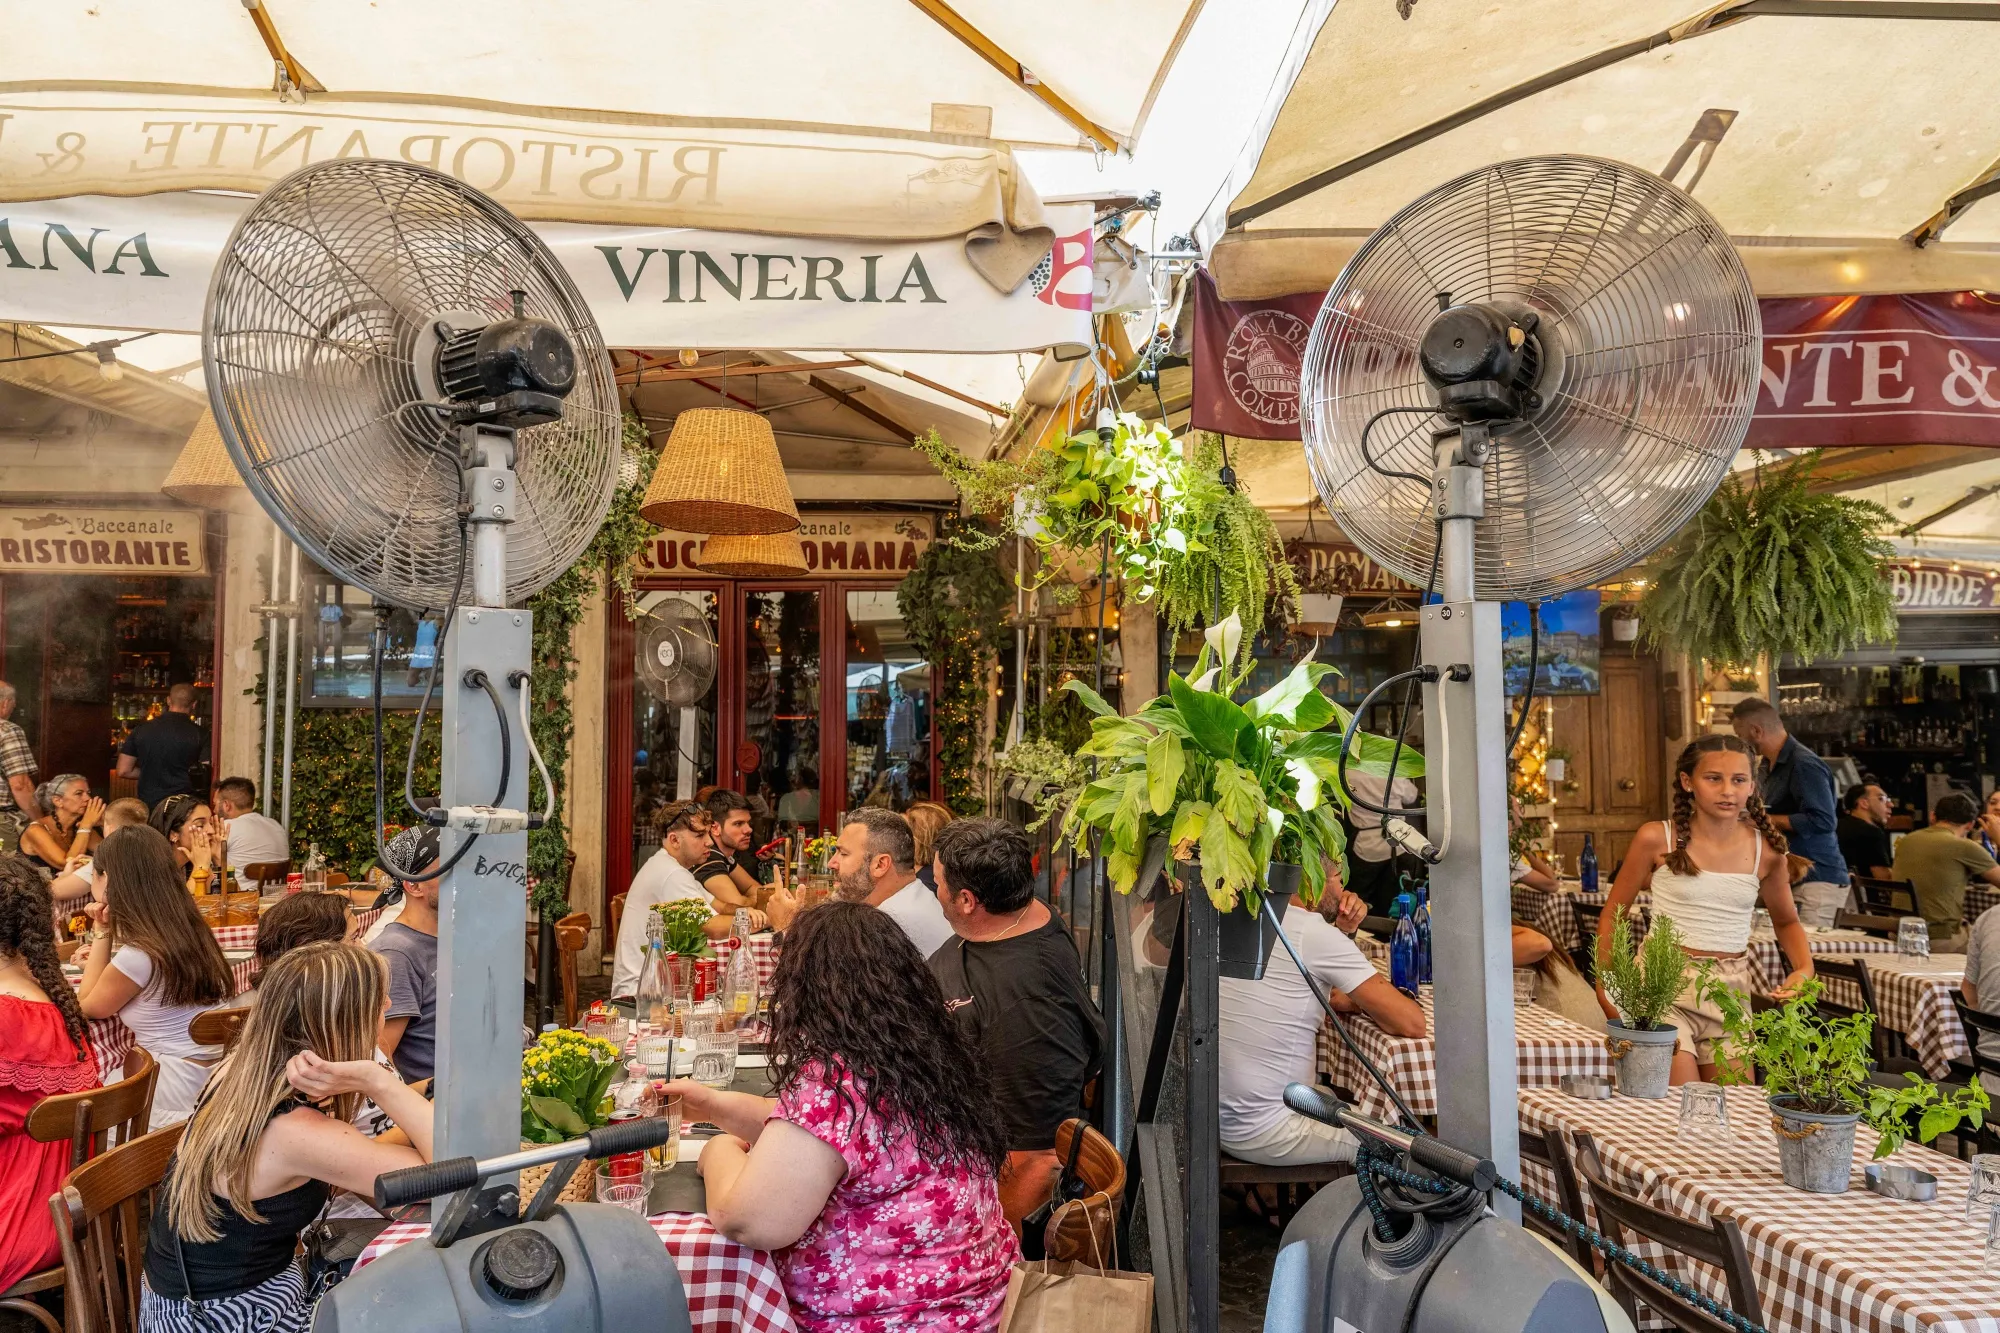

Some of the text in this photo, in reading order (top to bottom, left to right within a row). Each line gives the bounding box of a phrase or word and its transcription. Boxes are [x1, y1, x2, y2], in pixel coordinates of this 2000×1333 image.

[594, 246, 948, 303] VINERIA
[1226, 318, 1278, 361] ROMA
[1942, 349, 2000, 409] &
[1, 538, 191, 566] RISTORANTE
[802, 540, 919, 570] OMANA
[1892, 569, 1987, 606] BIRRE
[1441, 609, 1452, 618] 30
